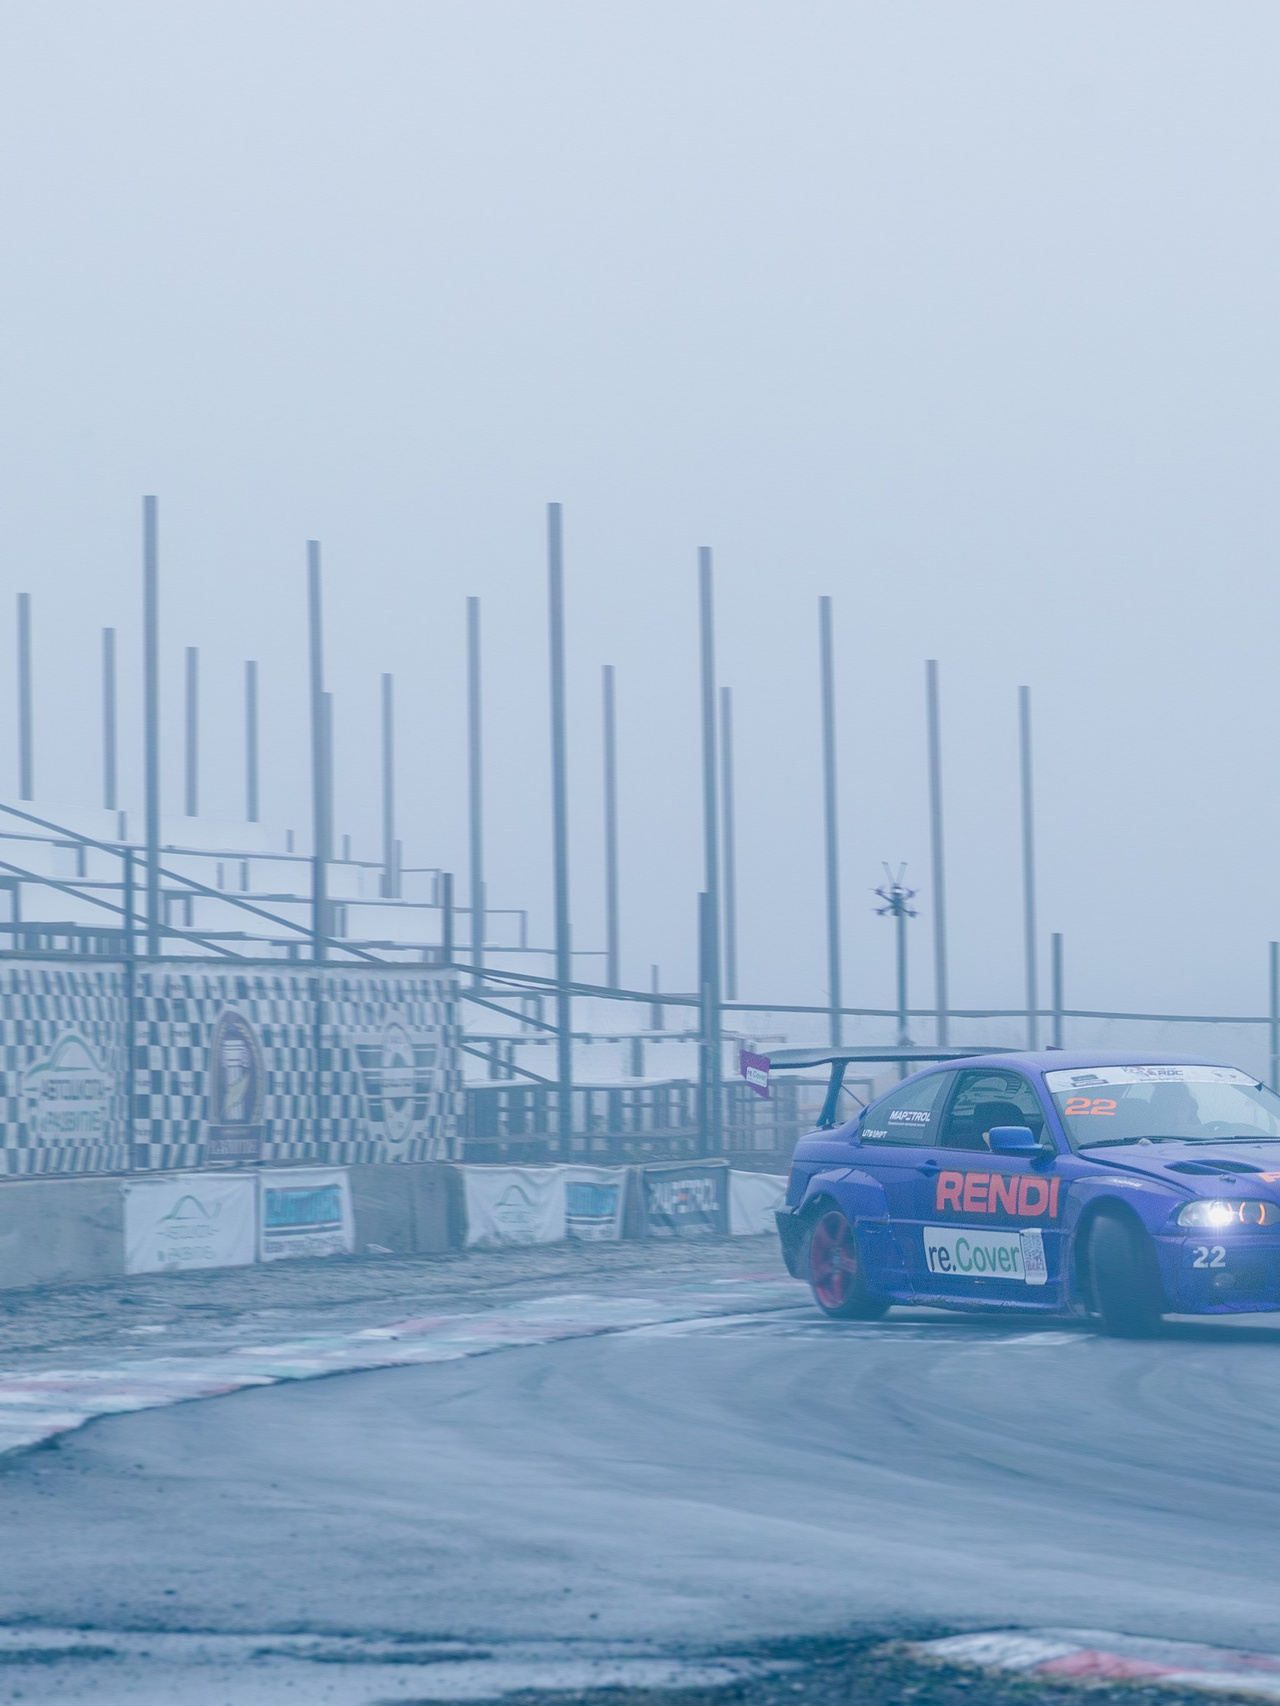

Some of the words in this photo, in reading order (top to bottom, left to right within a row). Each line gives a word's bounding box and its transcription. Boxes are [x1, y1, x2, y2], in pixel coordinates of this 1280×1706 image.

[1064, 1096, 1118, 1116] 22
[936, 1170, 1061, 1219] RENDI
[928, 1236, 1020, 1273] re.Cover
[1192, 1245, 1226, 1268] 22
